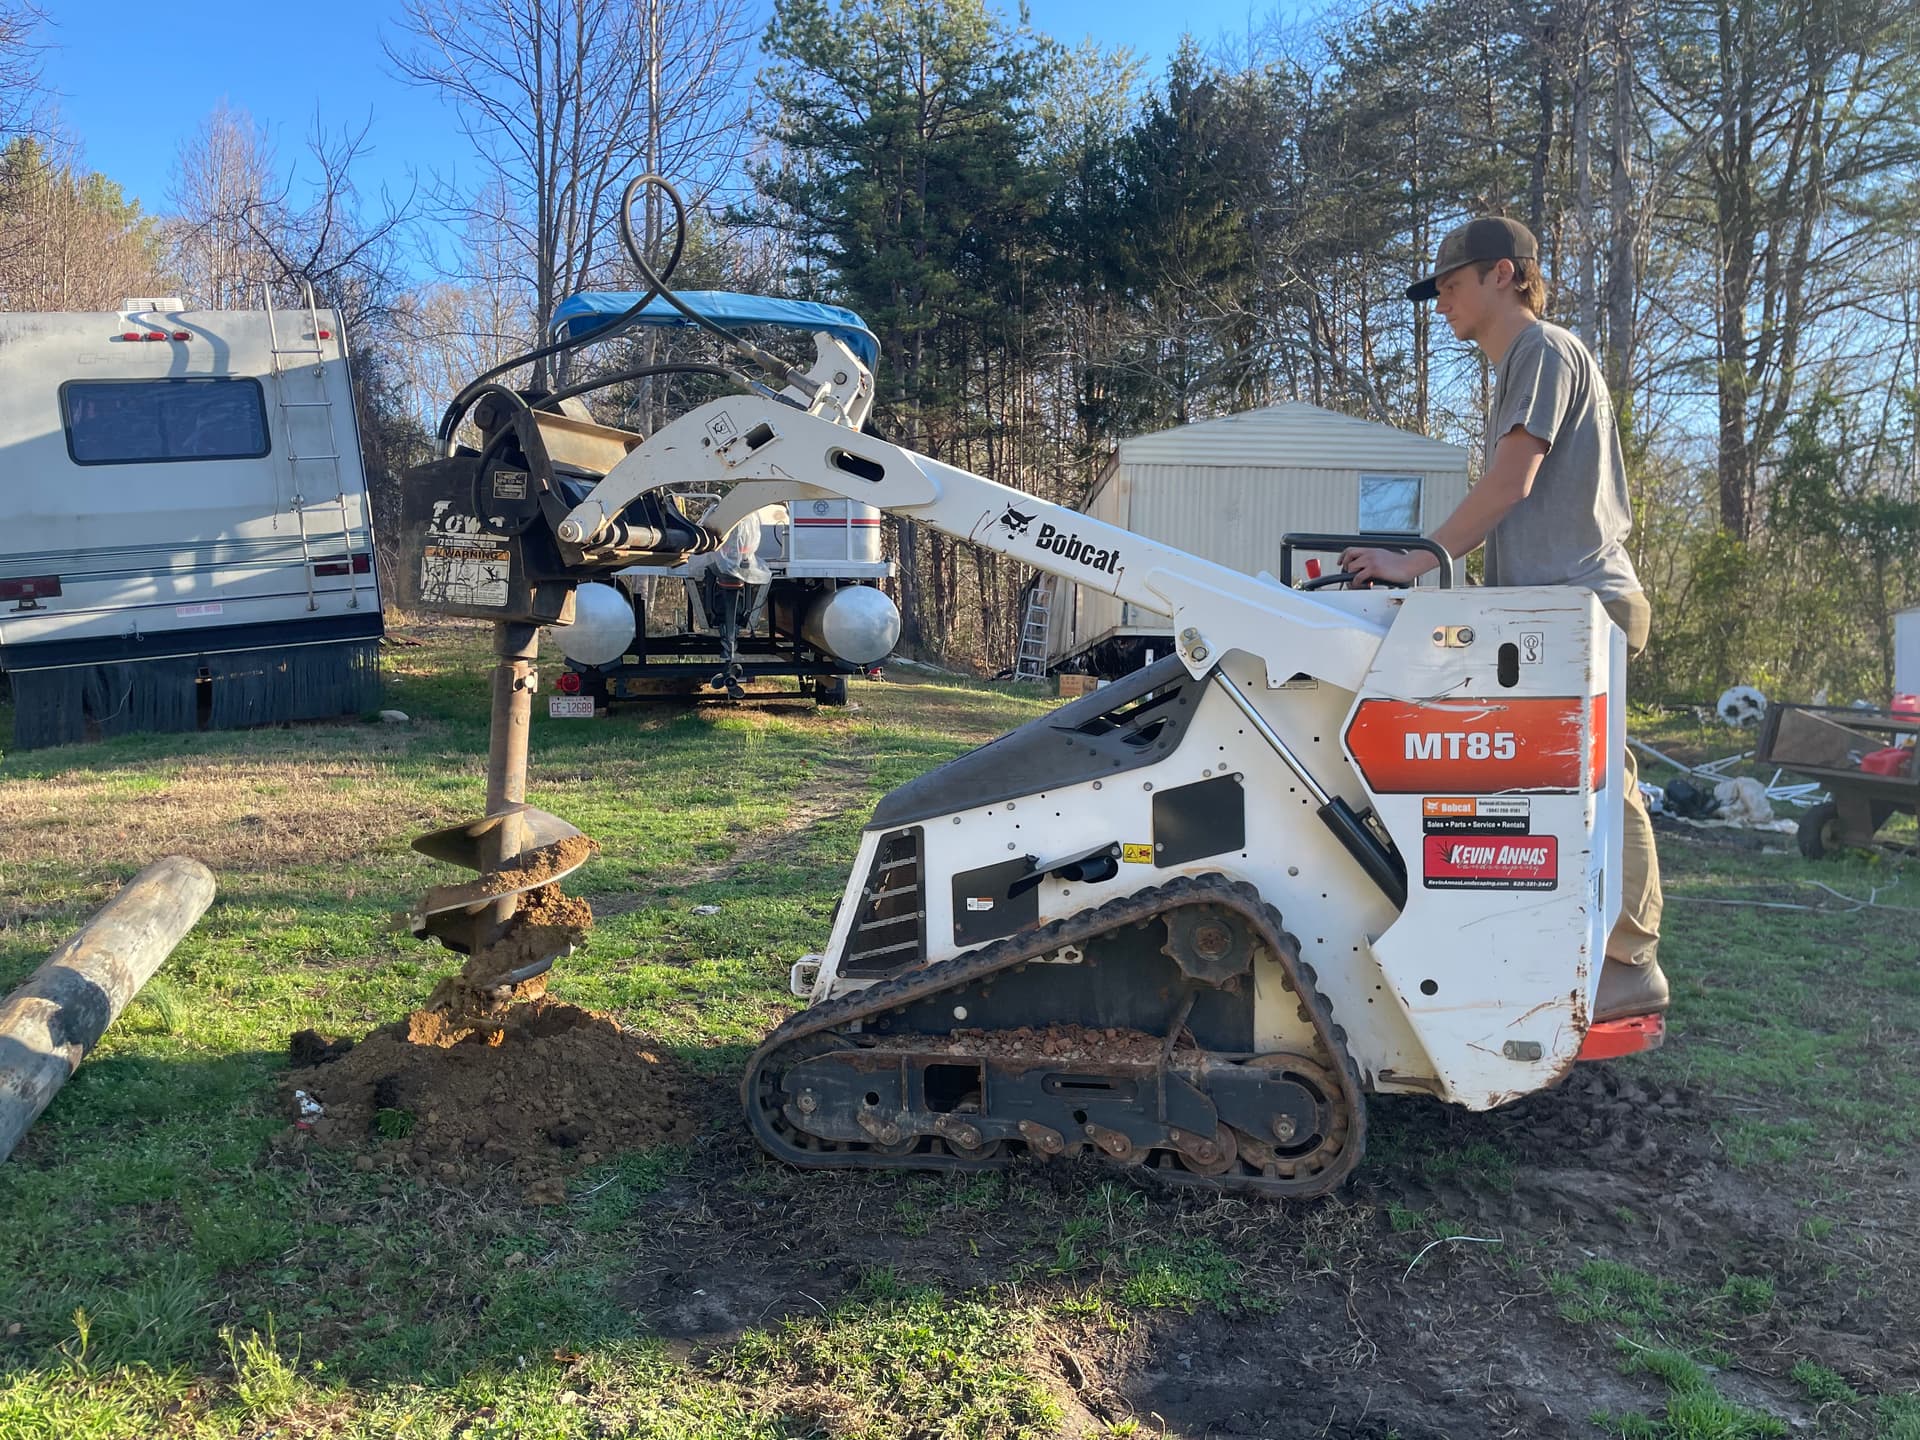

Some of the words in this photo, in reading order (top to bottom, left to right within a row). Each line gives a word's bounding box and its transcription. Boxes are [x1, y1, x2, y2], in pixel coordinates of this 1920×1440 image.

[445, 550, 498, 560] WARNING
[1036, 522, 1120, 574] Bobcat
[1404, 732, 1517, 761] MT85
[1441, 803, 1471, 813] Bobcat
[1427, 821, 1444, 829] Sales
[1450, 821, 1466, 829] Parts
[1472, 821, 1496, 829] Service
[1502, 821, 1525, 829] Rentals
[1450, 844, 1495, 864] KEVIN
[1496, 845, 1548, 865] ANNAS
